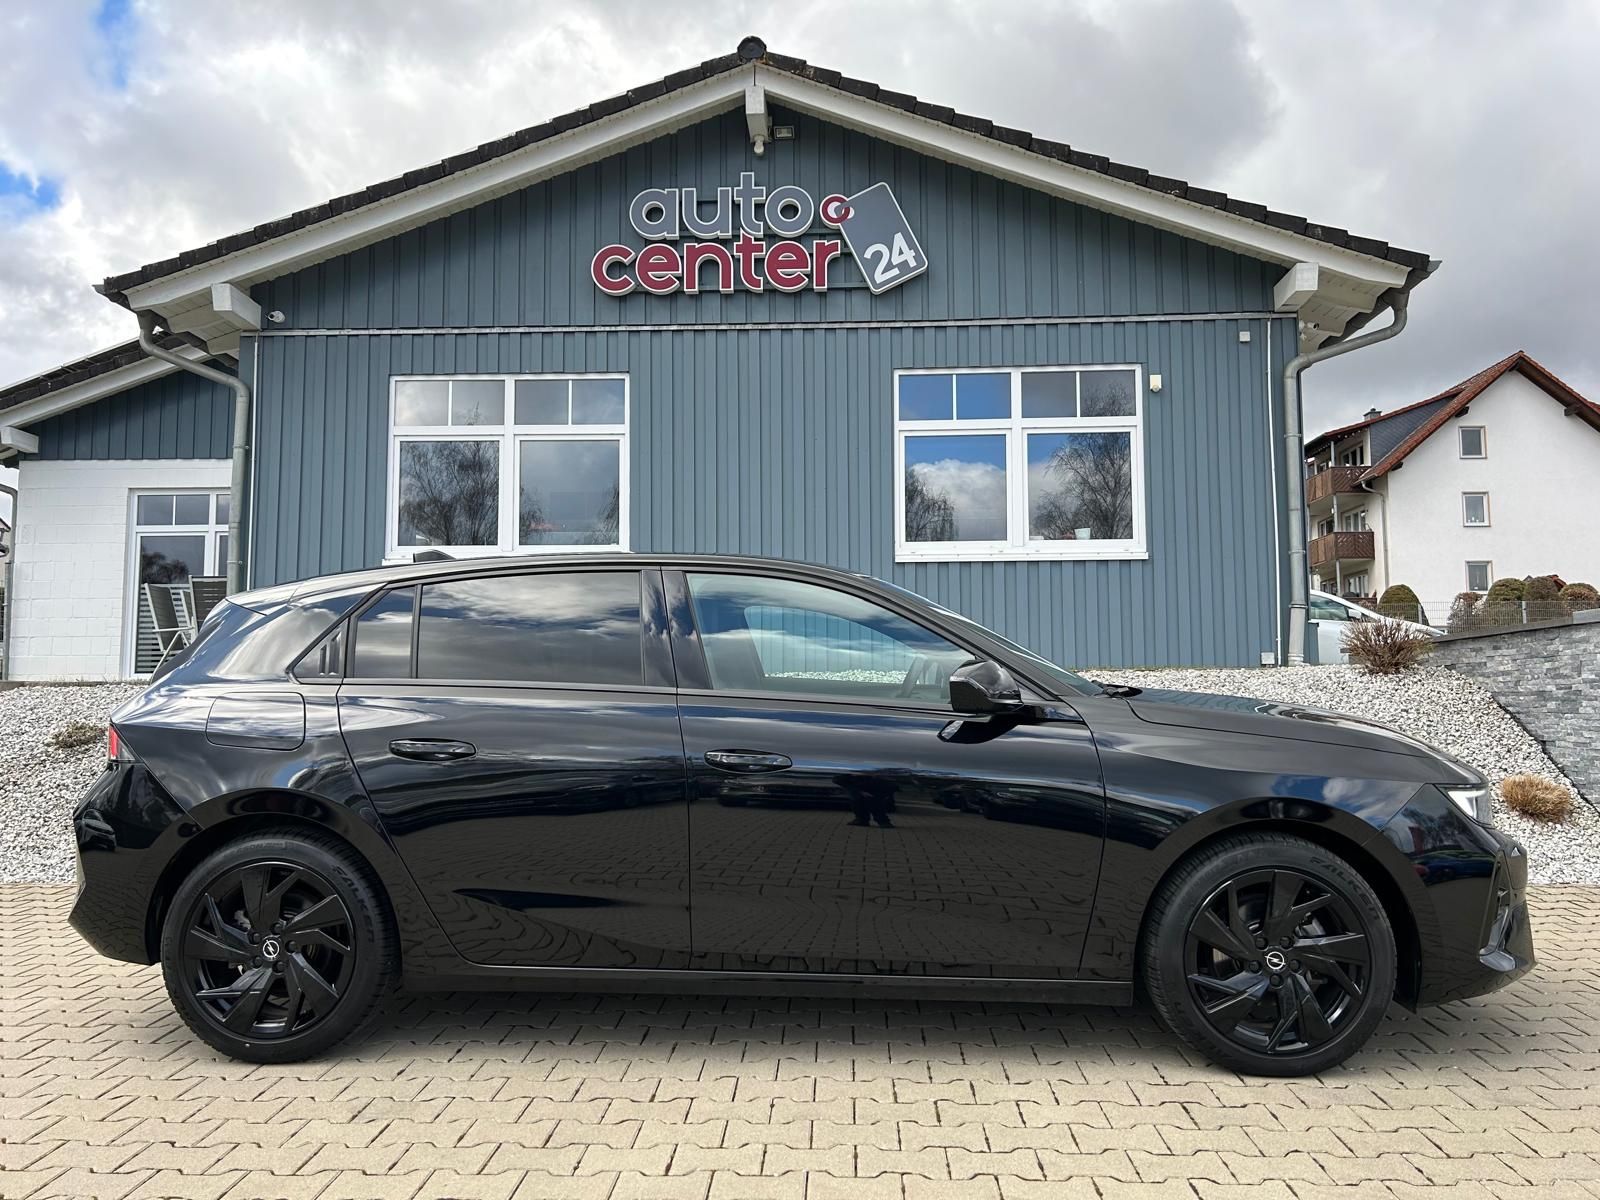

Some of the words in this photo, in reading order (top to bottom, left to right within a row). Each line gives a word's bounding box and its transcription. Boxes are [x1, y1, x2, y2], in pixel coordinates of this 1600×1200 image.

[629, 172, 815, 240] auto
[591, 229, 841, 296] center
[863, 231, 917, 284] 24
